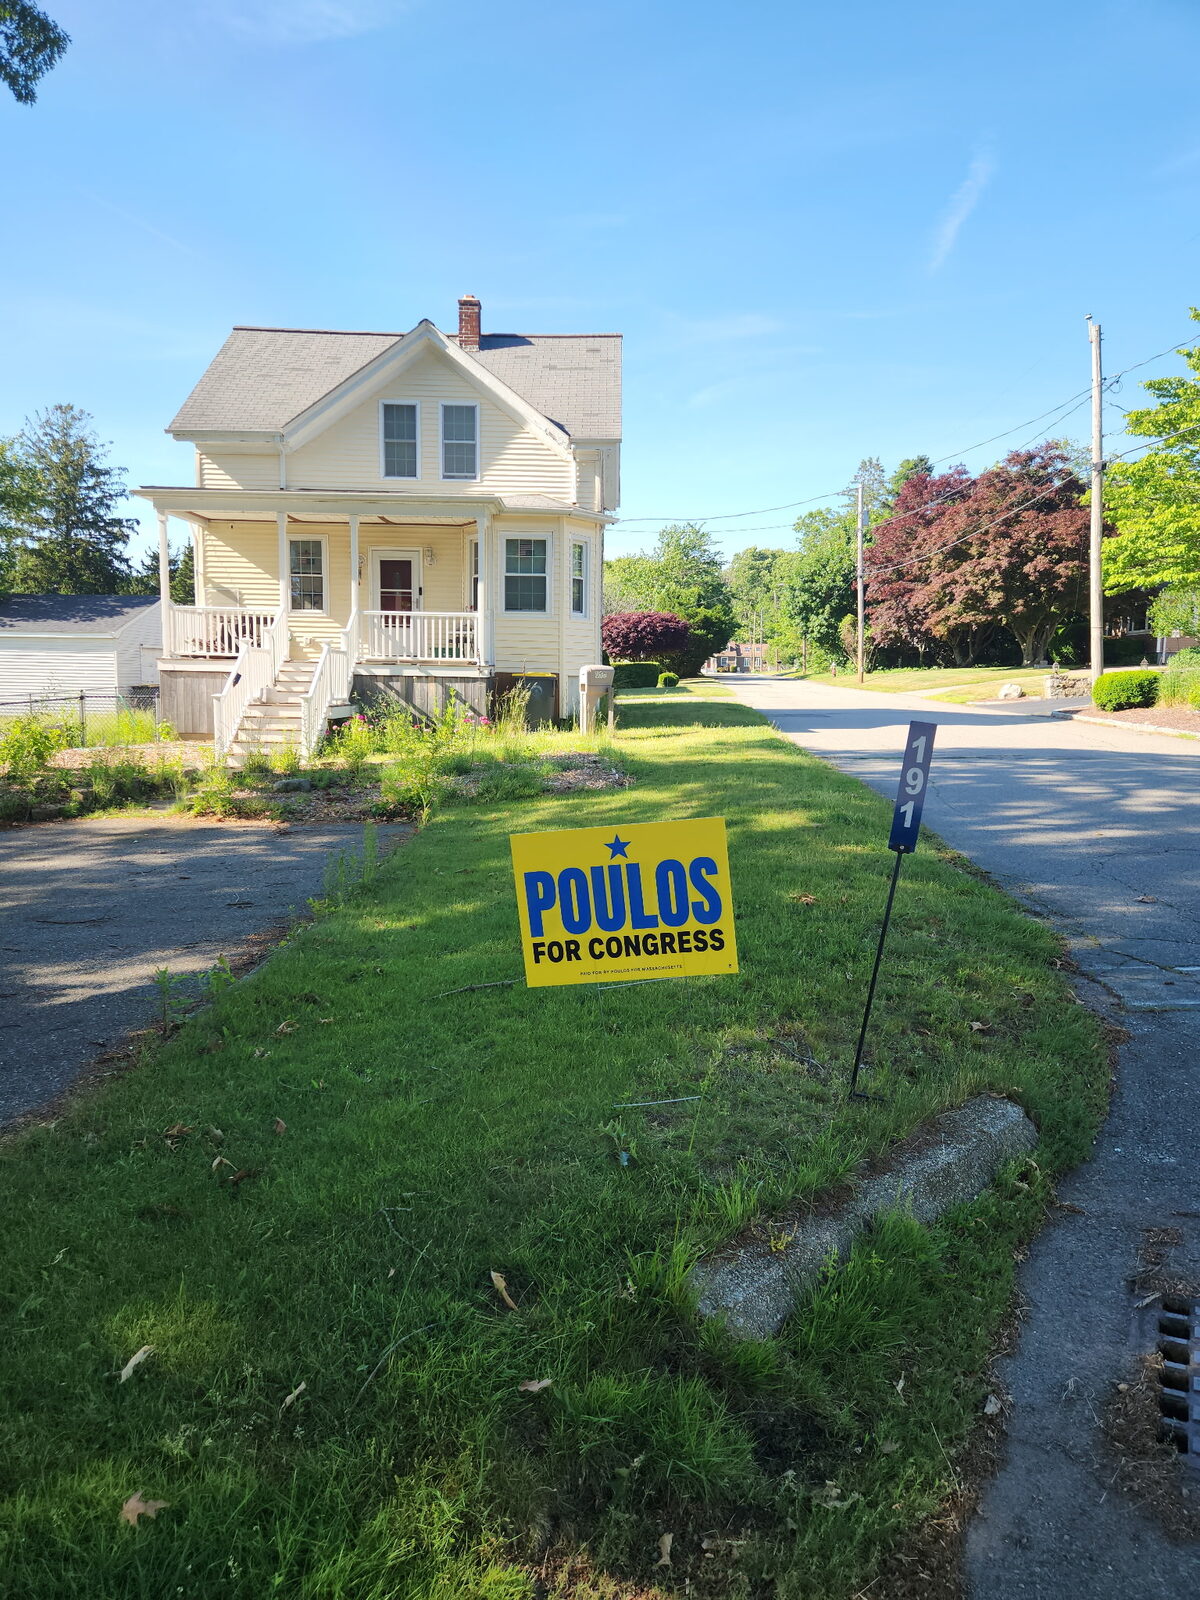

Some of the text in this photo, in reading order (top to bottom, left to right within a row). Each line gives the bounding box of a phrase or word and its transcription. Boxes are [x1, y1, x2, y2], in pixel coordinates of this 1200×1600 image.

[900, 735, 927, 828] 191
[524, 857, 722, 937] POULOS
[532, 929, 725, 964] FOR CONGRESS
